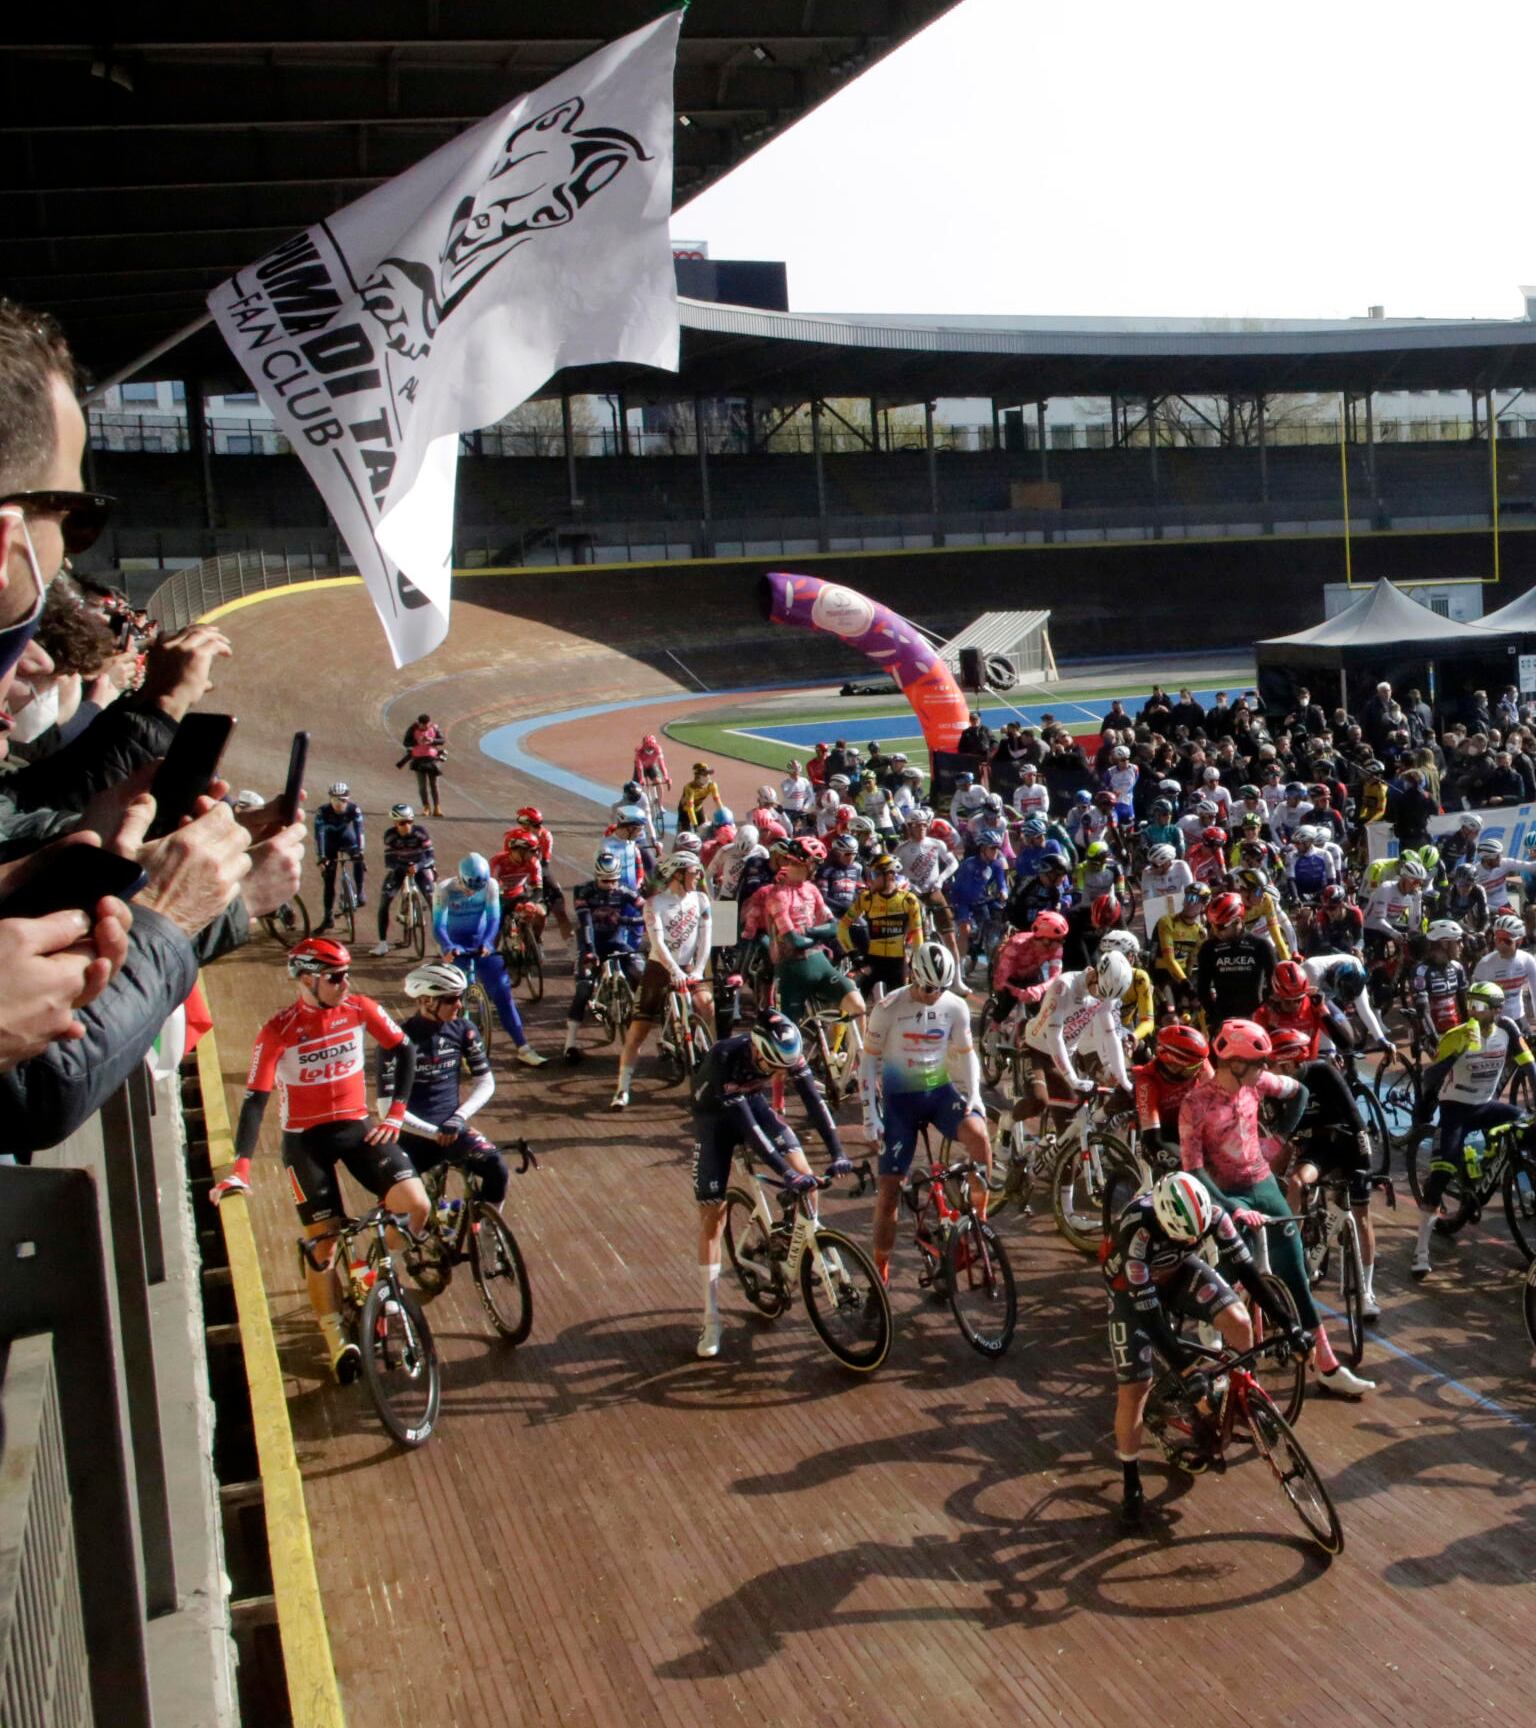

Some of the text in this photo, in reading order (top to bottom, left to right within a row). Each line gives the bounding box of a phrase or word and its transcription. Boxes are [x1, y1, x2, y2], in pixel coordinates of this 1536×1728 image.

[227, 291, 344, 447] FAN CLUB
[300, 323, 382, 399] DI
[1216, 956, 1256, 966] ARKEA
[247, 1043, 264, 1085] SOUDAL
[299, 1041, 357, 1066] SOUDAL
[789, 1223, 807, 1269] CANYON
